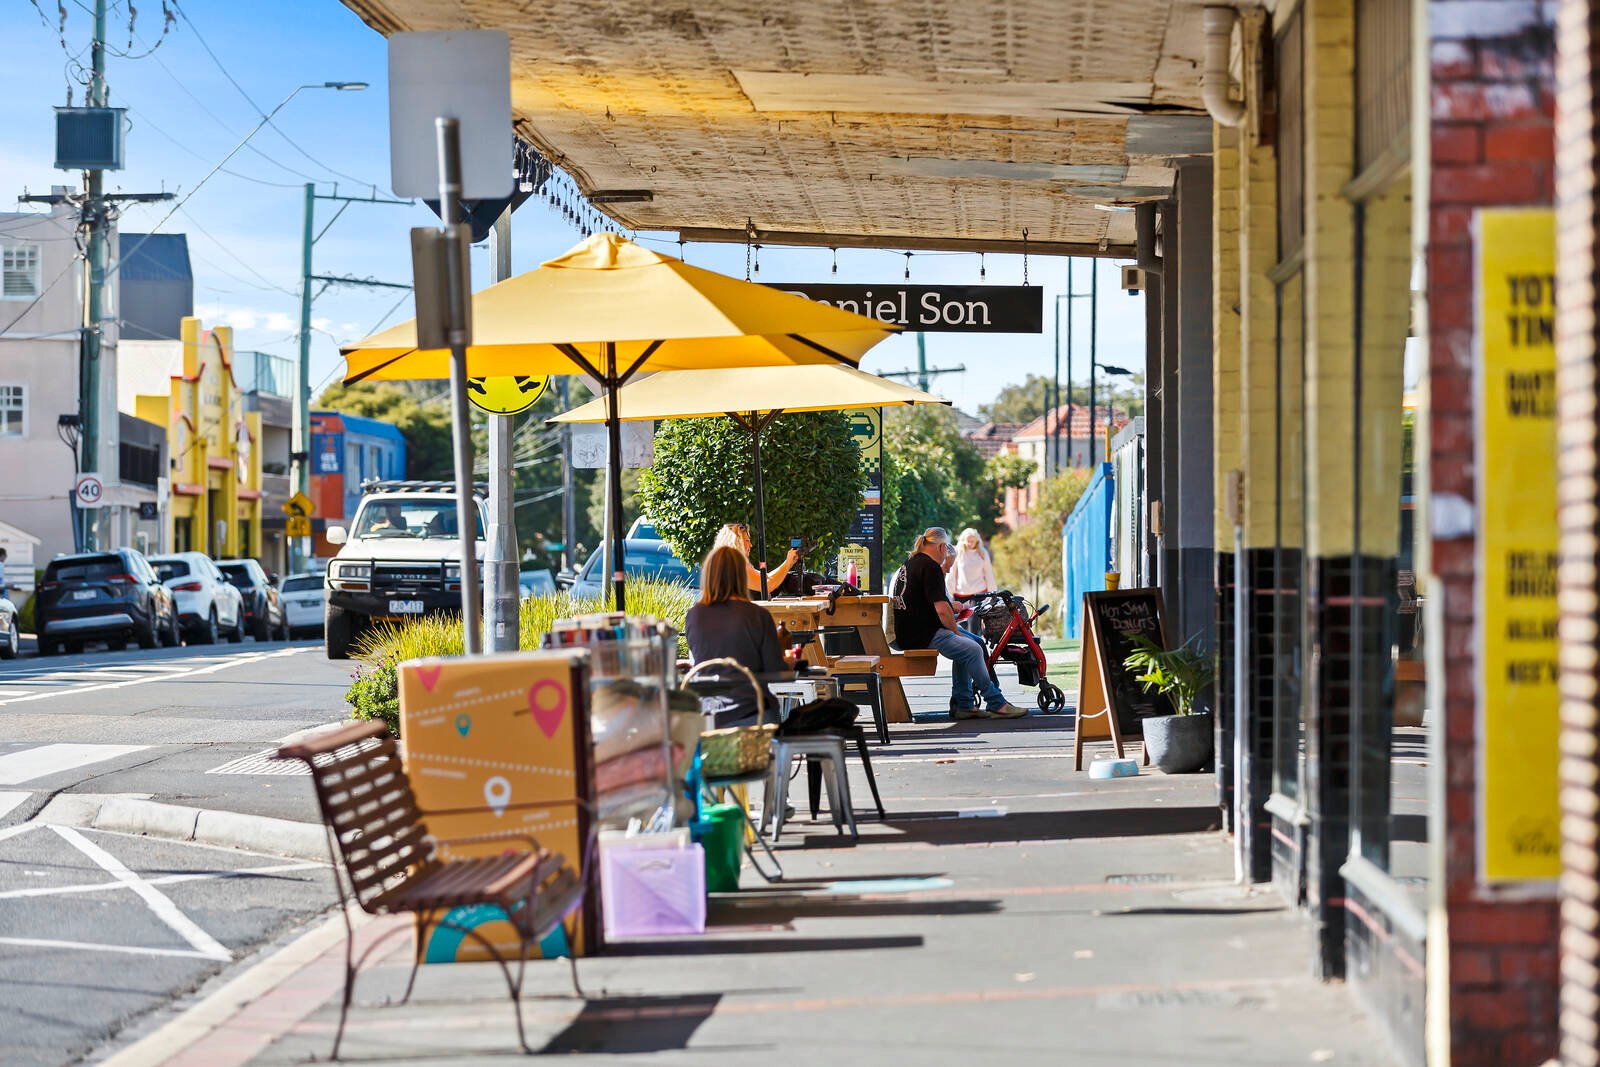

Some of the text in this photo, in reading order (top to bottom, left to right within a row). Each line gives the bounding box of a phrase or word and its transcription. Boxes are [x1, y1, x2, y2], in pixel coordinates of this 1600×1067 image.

[783, 290, 992, 325] niel Son
[81, 484, 100, 497] 40
[1100, 600, 1150, 618] HOT JAM
[1110, 616, 1156, 632] DONUTS
